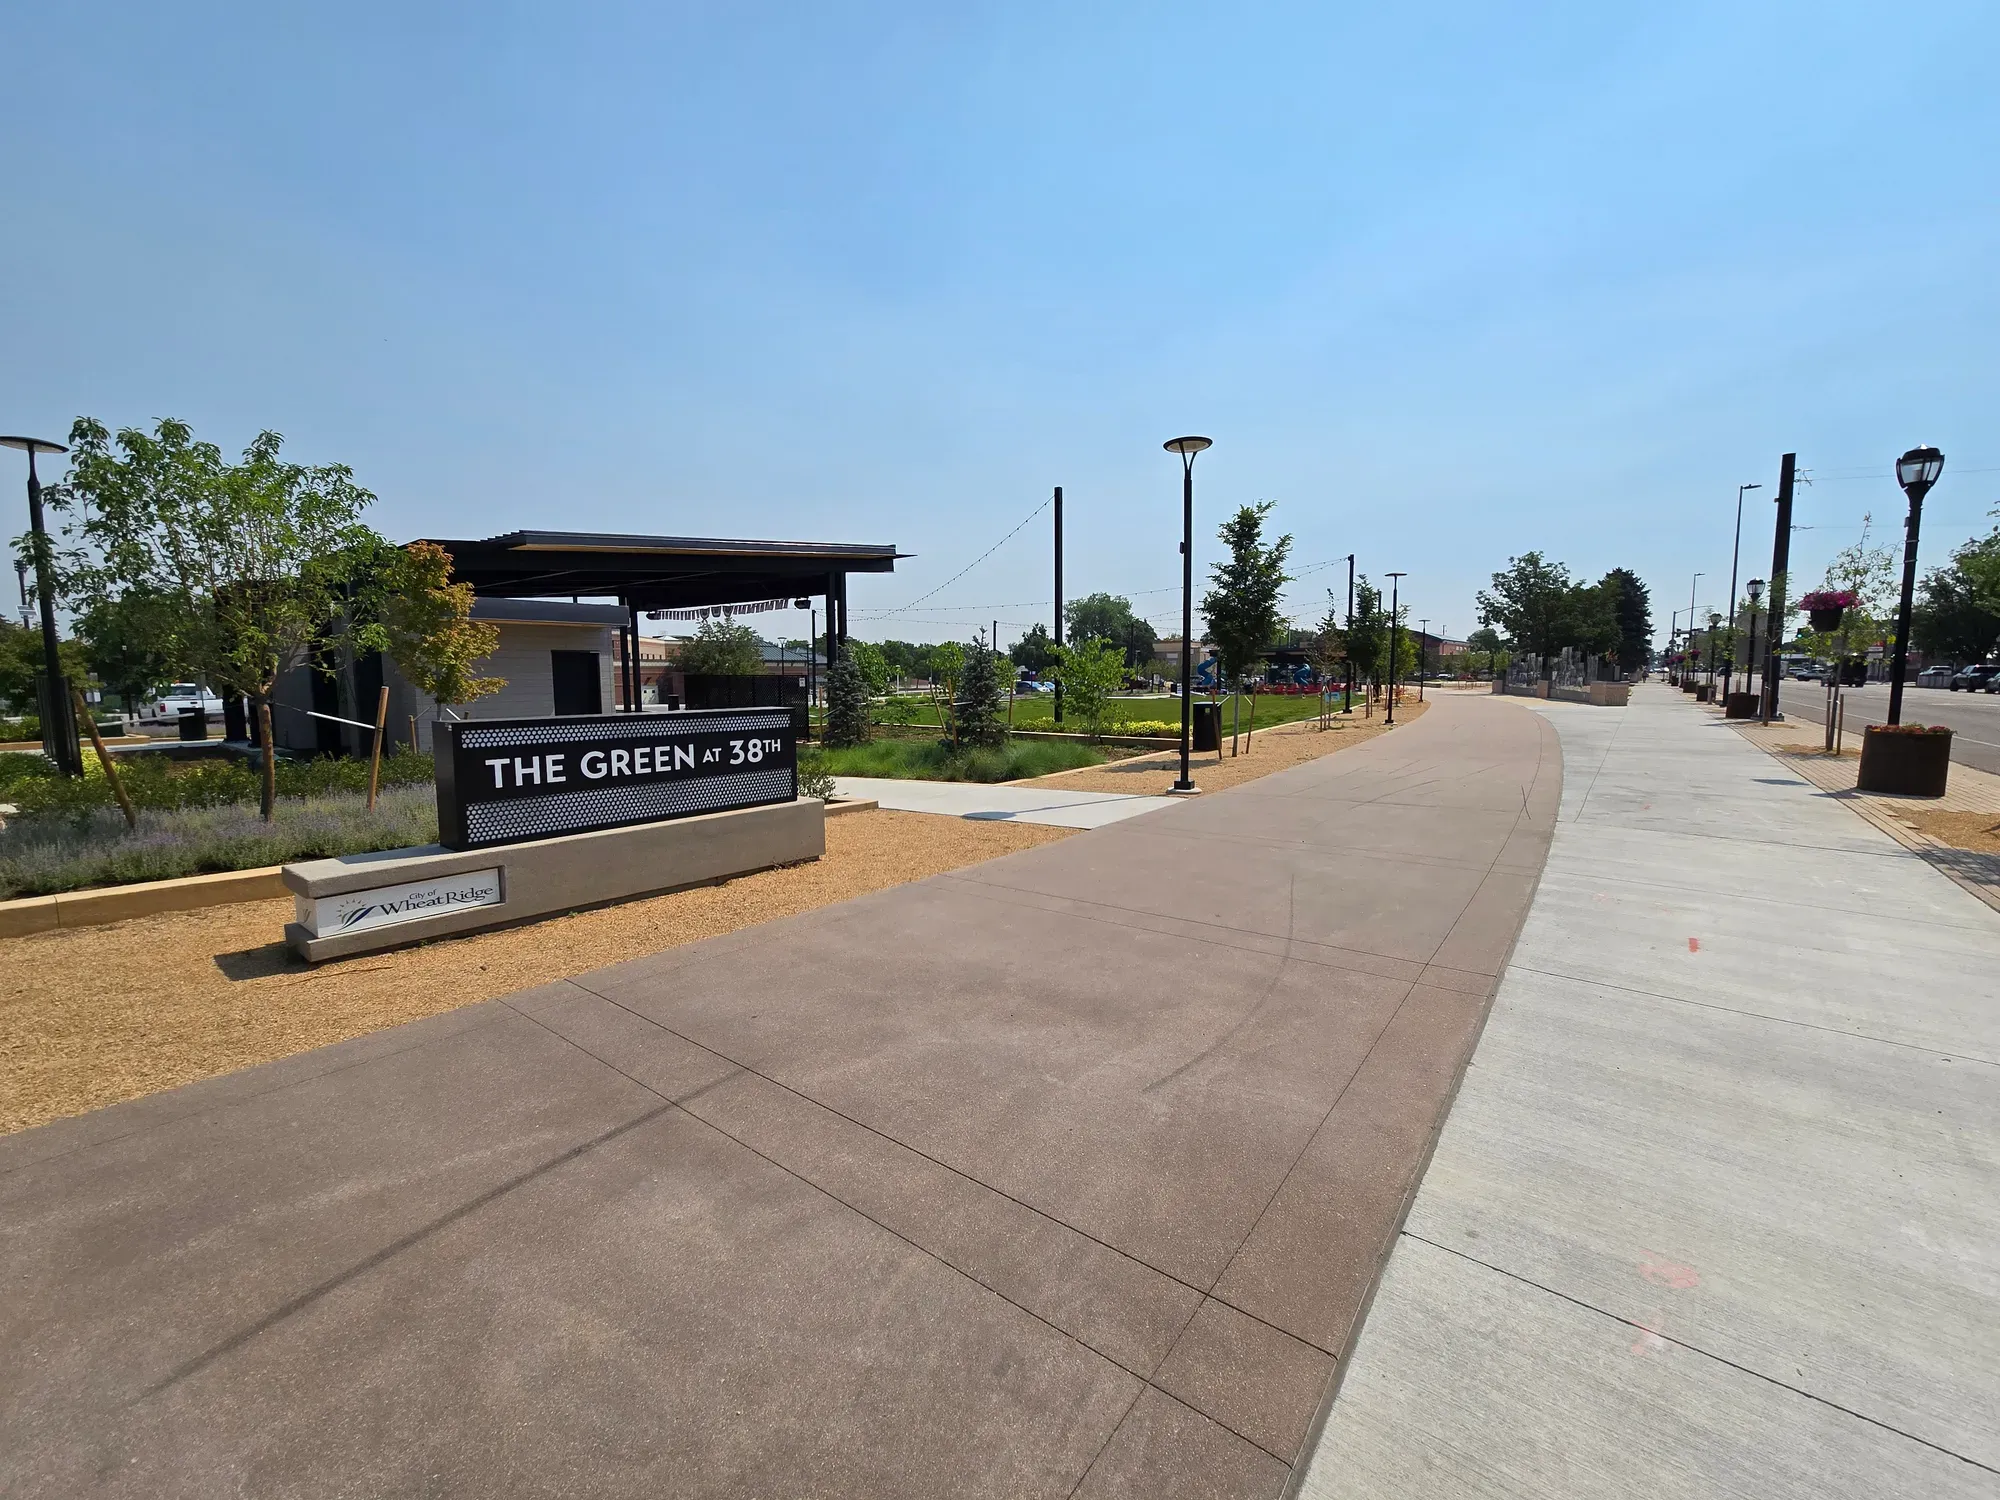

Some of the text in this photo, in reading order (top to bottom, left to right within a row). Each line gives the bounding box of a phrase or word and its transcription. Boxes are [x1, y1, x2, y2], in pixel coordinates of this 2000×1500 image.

[485, 738, 781, 789] THE GREEN AT 38TH
[379, 887, 494, 916] Wheat Ridge
[409, 889, 438, 900] City of
